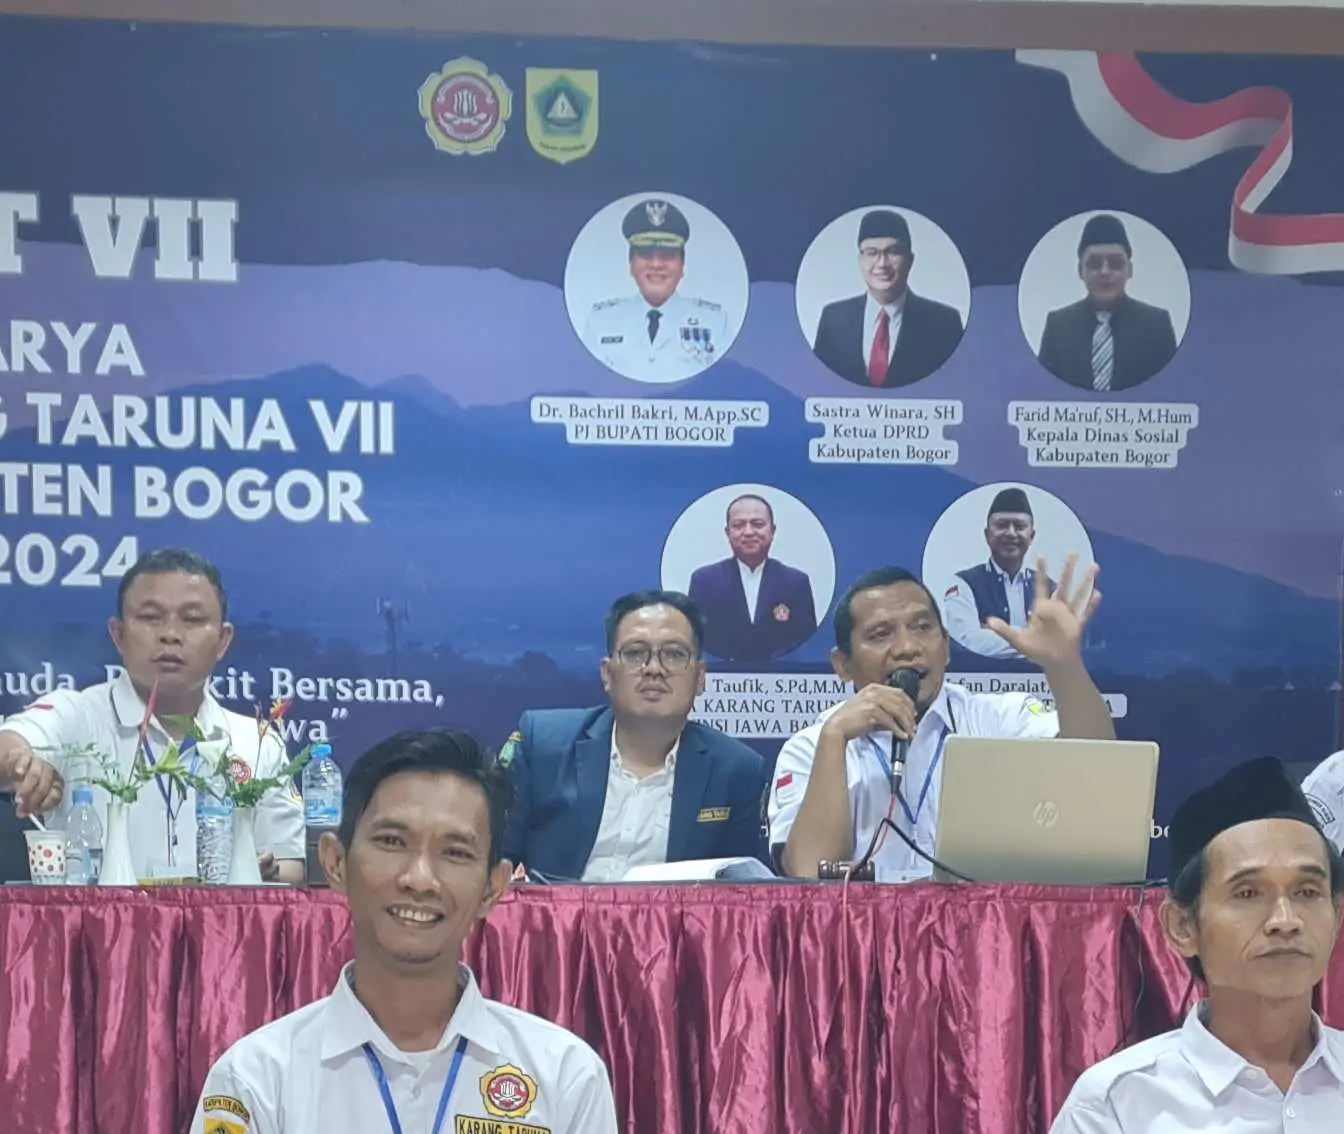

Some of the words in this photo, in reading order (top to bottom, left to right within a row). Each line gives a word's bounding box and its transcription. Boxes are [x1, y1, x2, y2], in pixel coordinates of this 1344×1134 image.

[72, 194, 238, 282] VII
[539, 403, 563, 419] Dr.
[569, 404, 625, 420] Bachril
[631, 405, 678, 422] Bakri,
[684, 406, 763, 425] M.App.SC
[812, 404, 861, 419] Sastra
[867, 404, 928, 421] Winara,
[933, 406, 956, 420] SH
[1014, 407, 1051, 423] Farid
[1137, 410, 1193, 425] M.Hum
[26, 392, 298, 453] TARUNA
[308, 400, 395, 455] VII
[833, 423, 877, 440] Ketua
[883, 425, 931, 440] DPRD
[574, 425, 591, 440] PJ
[596, 425, 658, 441] BUPATI
[664, 427, 727, 442] BOGOR
[1026, 428, 1079, 446] Kepala
[1084, 429, 1129, 445] Dinas
[1134, 429, 1180, 445] Sosial
[816, 444, 902, 463] Kabupaten
[906, 446, 952, 464] Bogor
[1035, 448, 1120, 467] Kabupaten
[1124, 449, 1171, 467] Bogor
[134, 465, 372, 524] BOGOR
[269, 666, 445, 708] Bersama,
[712, 679, 769, 696] Taufik,
[704, 699, 776, 714] KARANG
[735, 720, 783, 734] JAWA
[1034, 800, 1059, 828] hp
